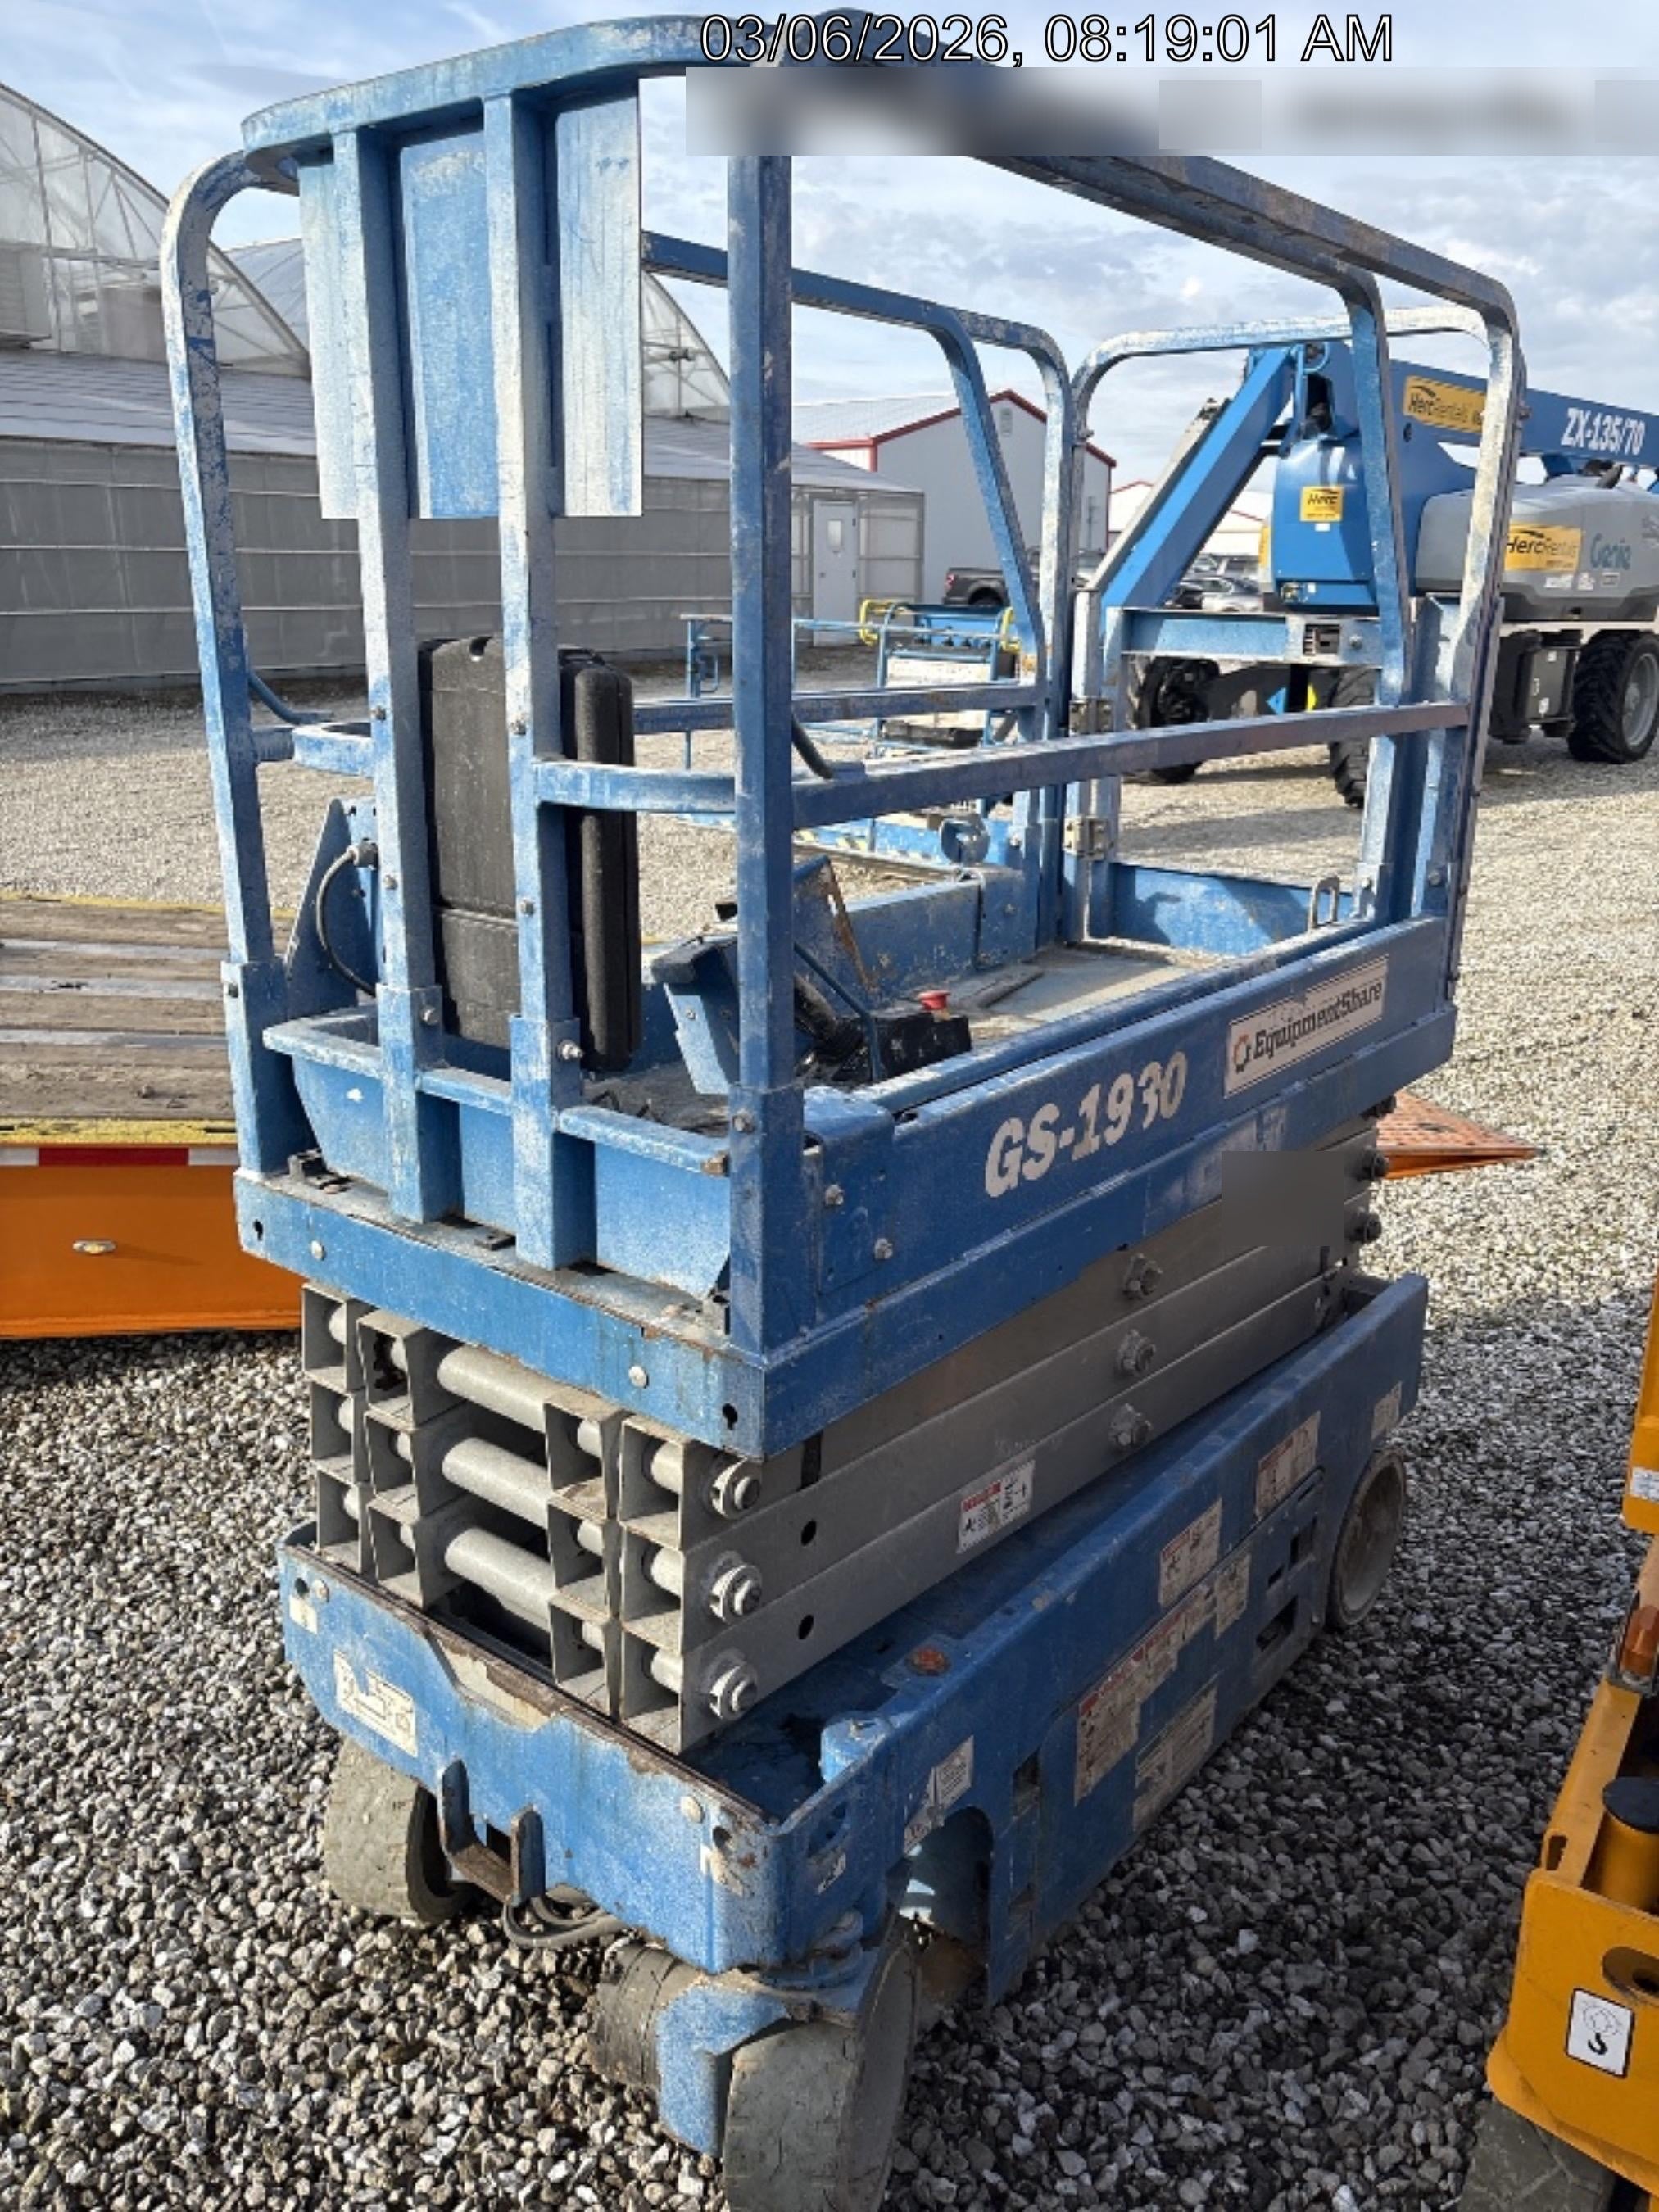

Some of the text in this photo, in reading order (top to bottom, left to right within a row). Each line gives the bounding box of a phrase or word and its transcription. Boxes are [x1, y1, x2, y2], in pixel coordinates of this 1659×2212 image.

[1561, 407, 1645, 456] ZX-135/70
[1590, 533, 1632, 570] Genie
[1253, 982, 1382, 1059] EquipmentShare
[985, 1051, 1188, 1199] GS-1930
